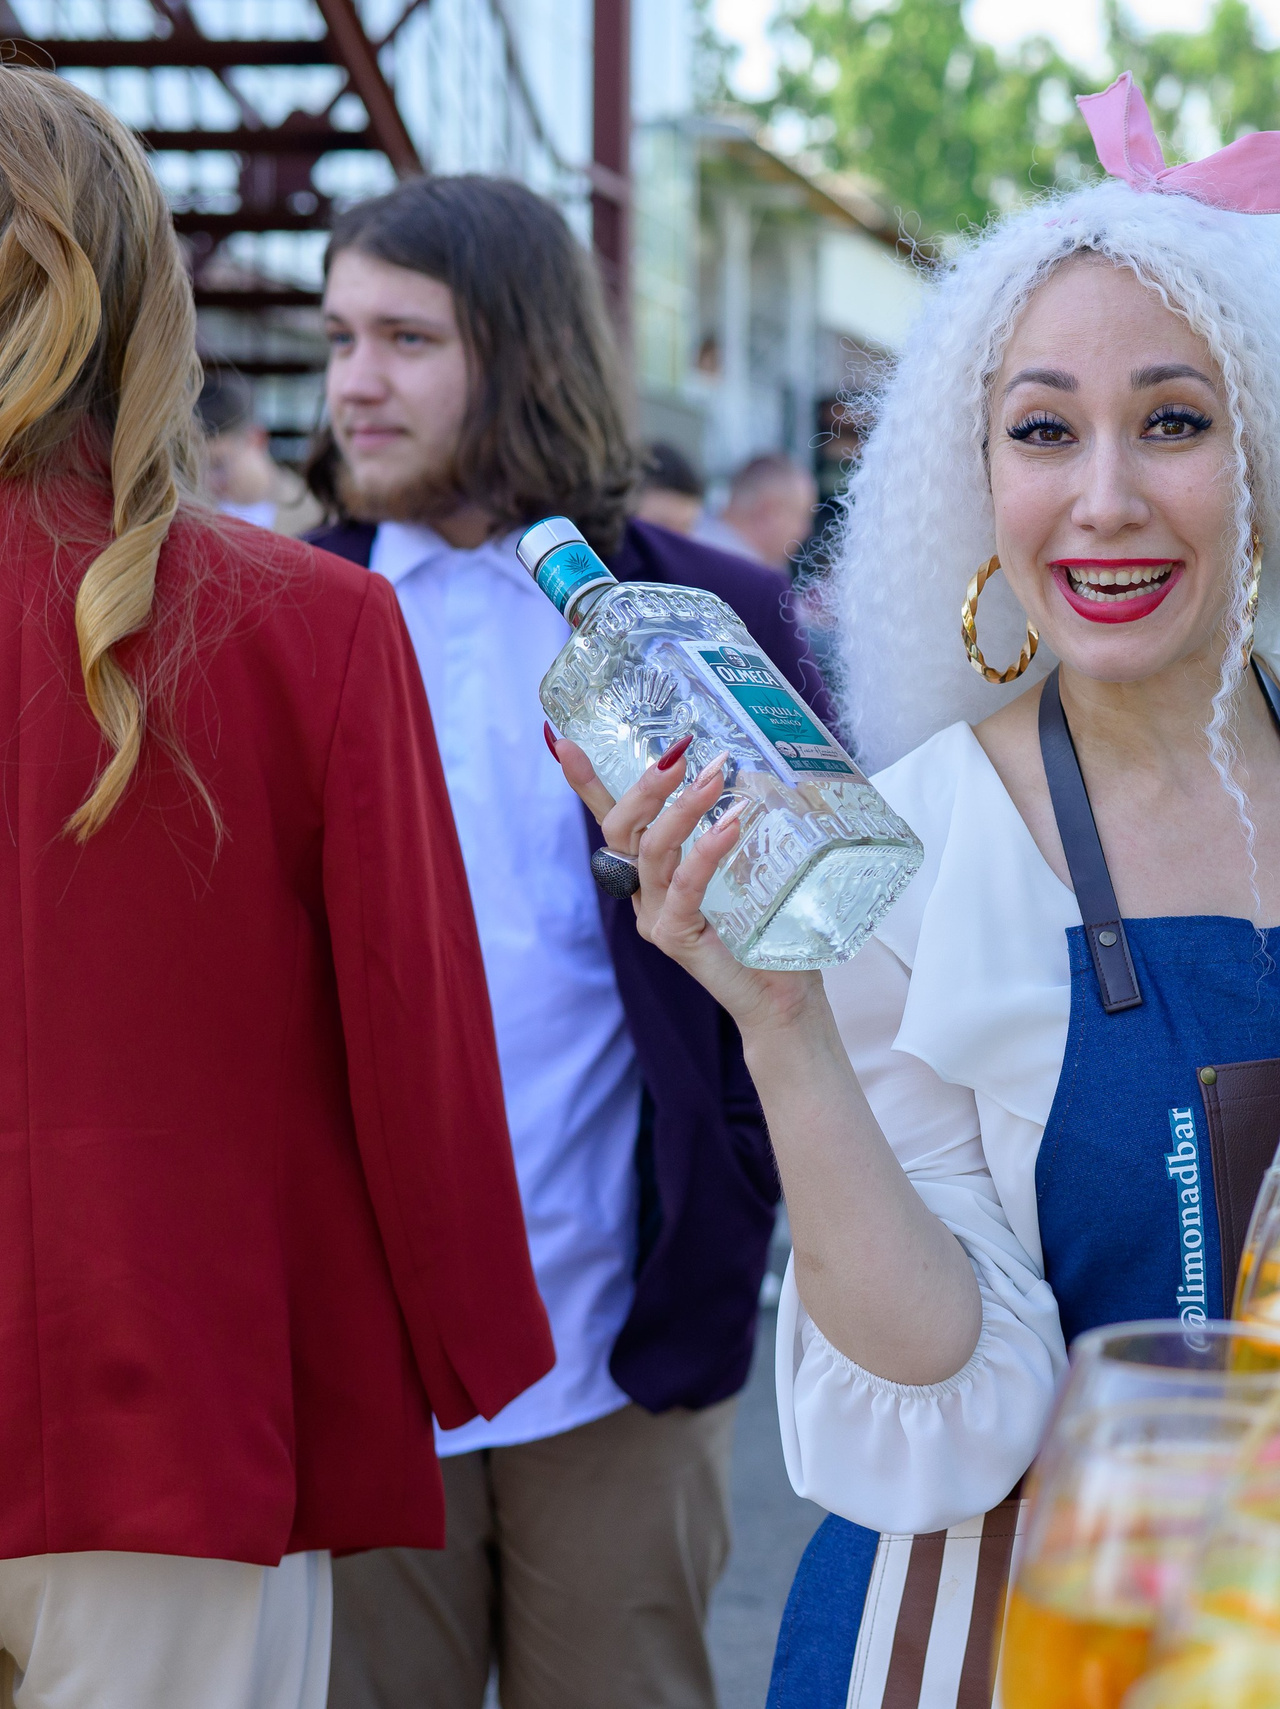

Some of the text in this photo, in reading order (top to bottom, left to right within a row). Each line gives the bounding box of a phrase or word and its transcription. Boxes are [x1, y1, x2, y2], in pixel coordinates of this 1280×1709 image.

[717, 666, 780, 687] OLMECA
[749, 705, 803, 718] TEQUILA
[770, 718, 801, 726] BLANCO
[1167, 1107, 1211, 1352] @limonadbar
